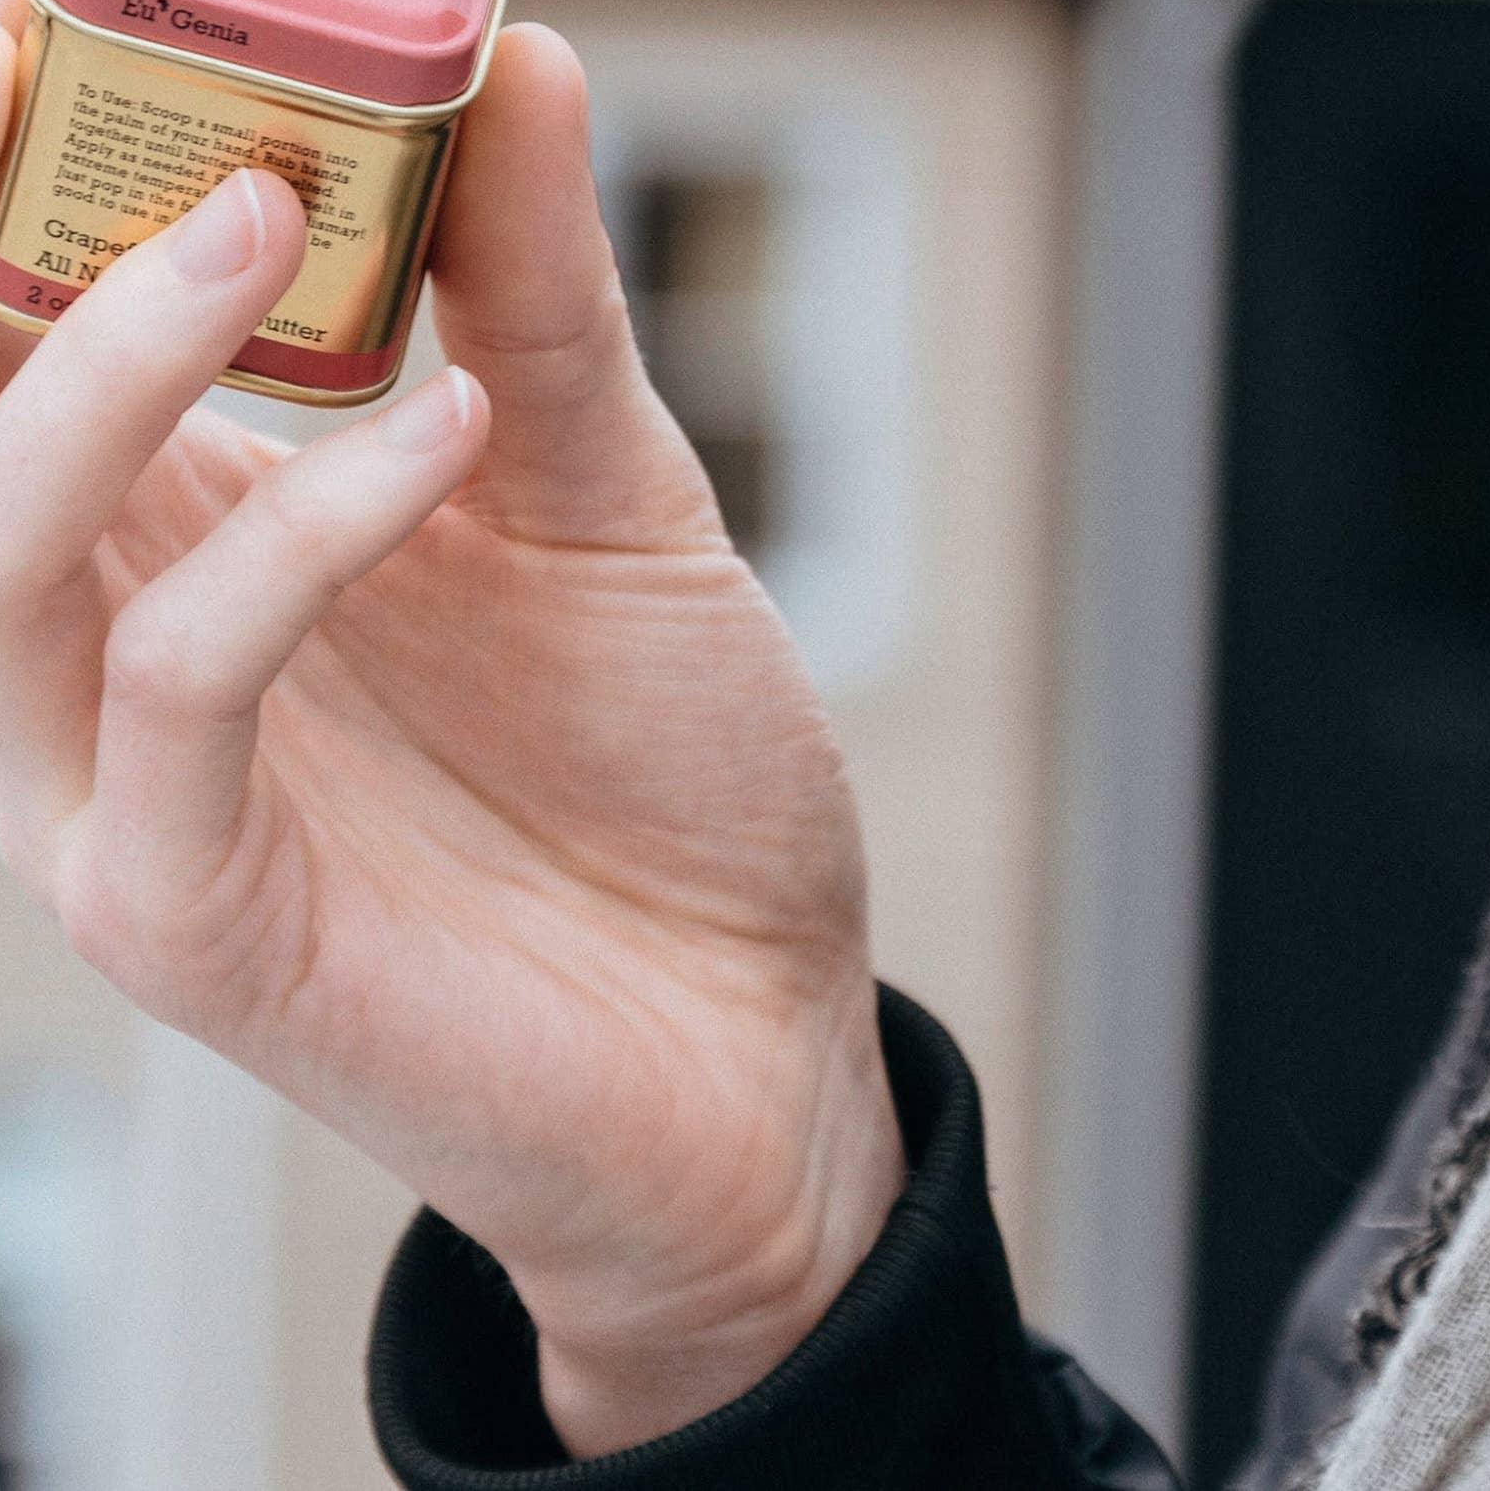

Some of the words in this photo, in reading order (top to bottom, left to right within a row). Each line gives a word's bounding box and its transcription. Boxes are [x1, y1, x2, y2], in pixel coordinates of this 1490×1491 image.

[61, 151, 129, 178] extreme
[69, 117, 140, 146] together
[144, 139, 182, 158] until
[281, 174, 337, 199] elted.
[73, 101, 99, 117] the
[102, 111, 146, 130] palm
[150, 122, 170, 136] of
[171, 129, 209, 147] your
[213, 137, 259, 160] hand.
[263, 151, 295, 170] Rub
[300, 161, 350, 185] hands
[77, 83, 97, 98] To
[141, 101, 191, 126] Scoop
[197, 119, 206, 128] a
[210, 122, 255, 141] small
[259, 135, 321, 160] portion
[326, 150, 358, 169] into
[52, 184, 96, 204] good
[99, 196, 116, 210] to
[120, 204, 149, 219] use
[64, 132, 116, 159] Apply
[119, 151, 137, 163] as
[141, 157, 210, 182] needed.
[339, 207, 356, 221] in
[89, 178, 124, 196] pop
[128, 187, 144, 201] in
[149, 192, 175, 208] the
[310, 234, 332, 249] be
[25, 285, 43, 305] 2
[48, 297, 72, 310] o
[34, 250, 72, 276] All
[264, 315, 328, 343] utter
